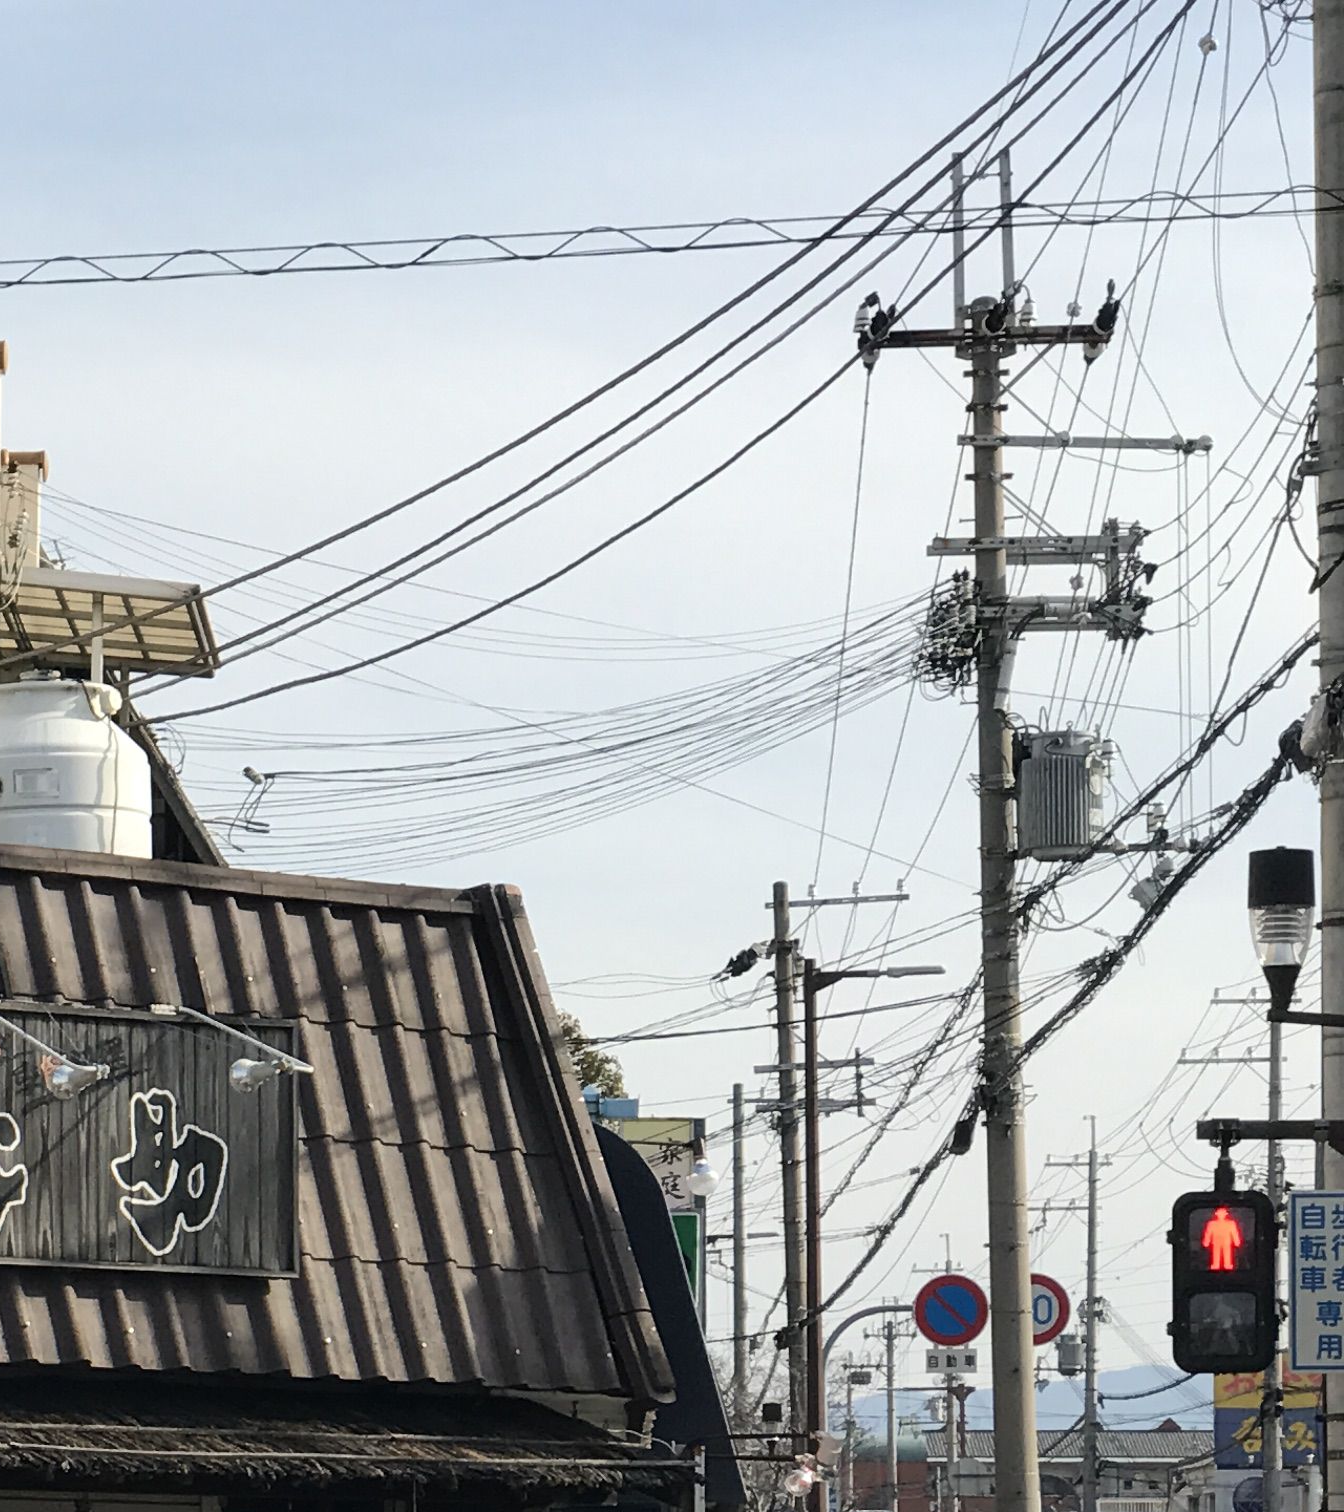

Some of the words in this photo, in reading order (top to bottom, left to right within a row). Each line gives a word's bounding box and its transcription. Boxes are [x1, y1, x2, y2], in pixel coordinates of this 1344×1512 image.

[1299, 1203, 1327, 1293] 自転車
[1315, 1300, 1343, 1360] 専用
[927, 1354, 975, 1369] 自動車
